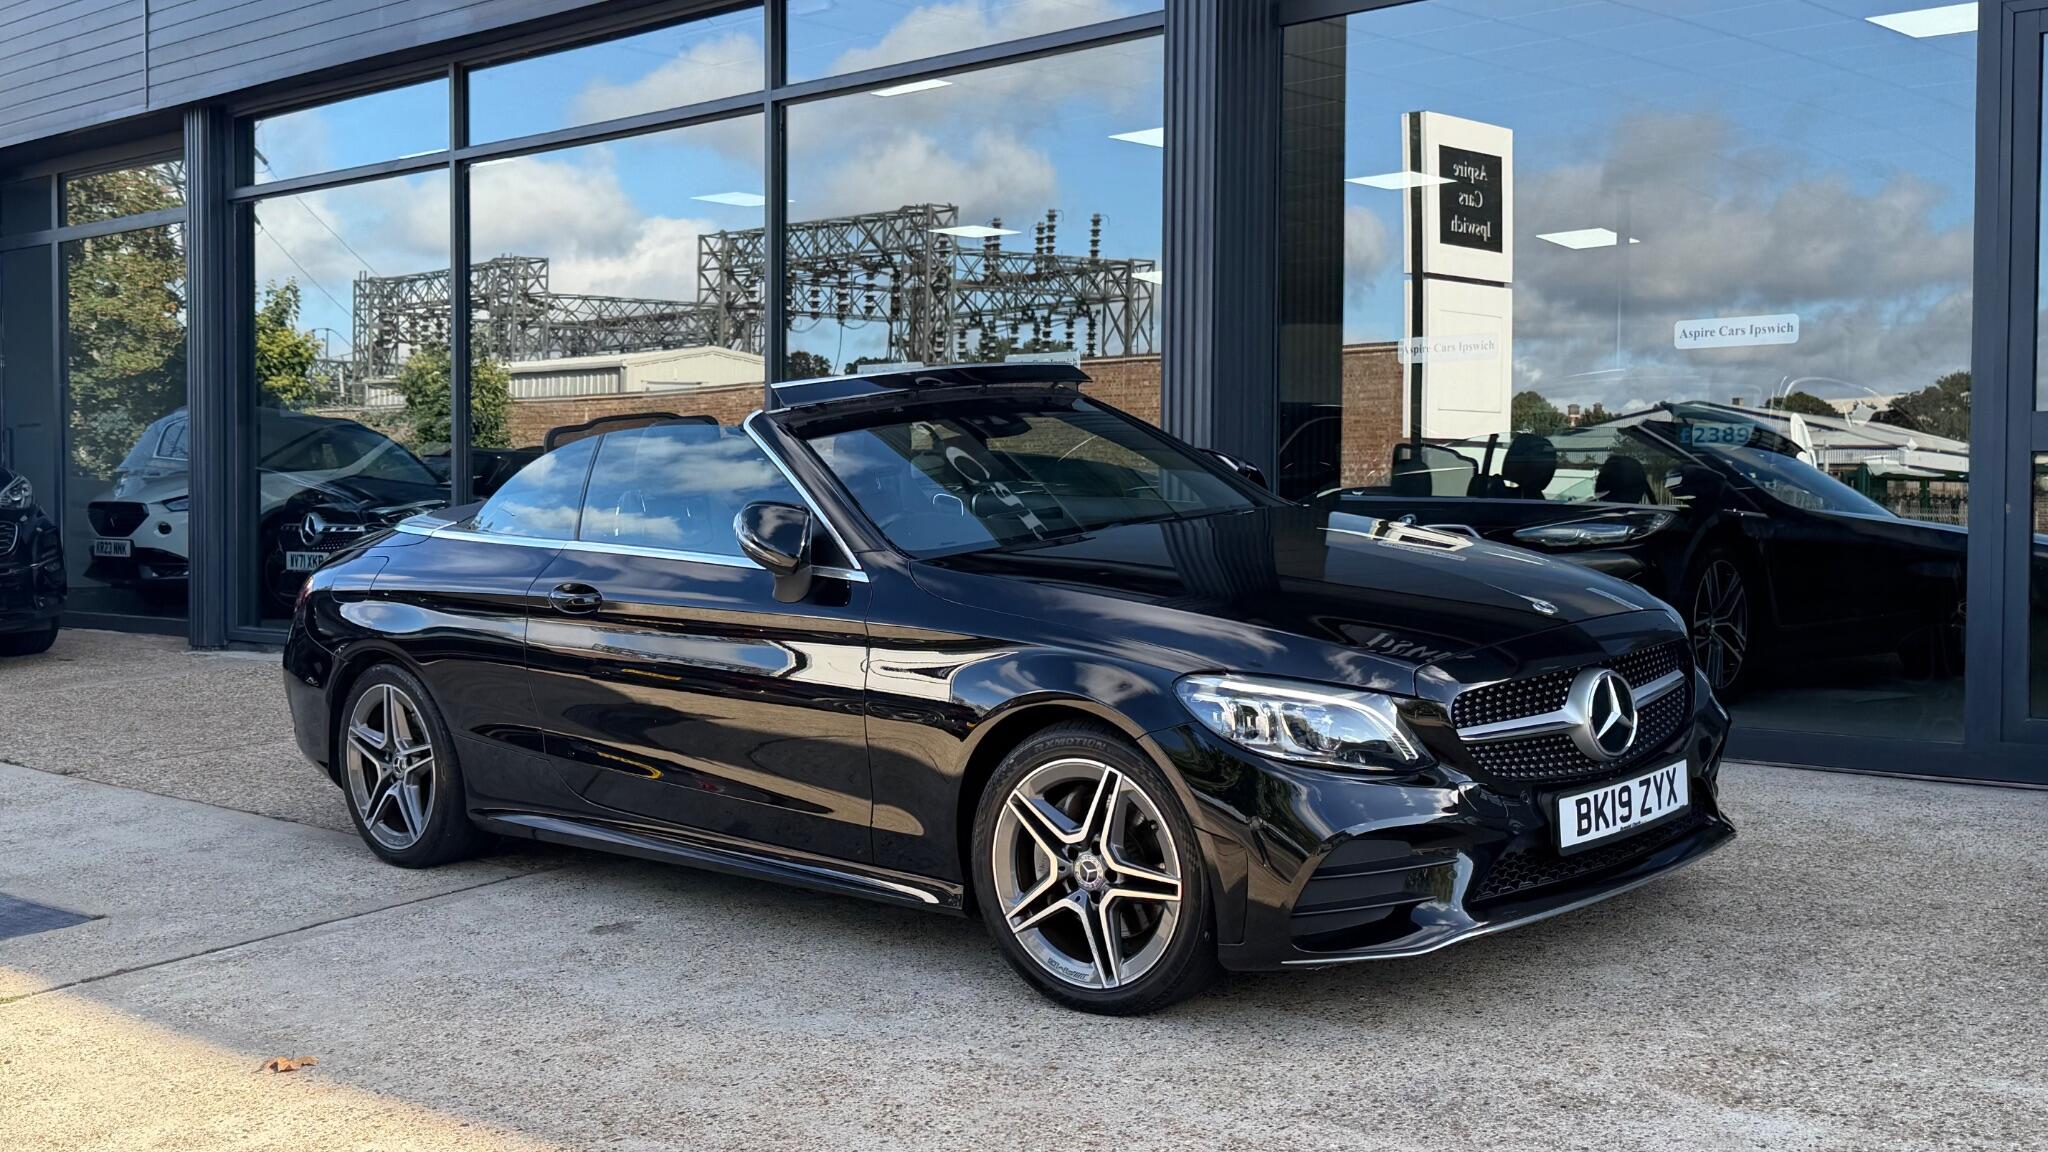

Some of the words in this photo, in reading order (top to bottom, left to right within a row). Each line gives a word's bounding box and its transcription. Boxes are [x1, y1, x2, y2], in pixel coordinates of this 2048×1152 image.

[1680, 327, 1716, 341] Aspire
[1719, 325, 1746, 337] Cars
[1750, 322, 1794, 338] Ipswich
[1458, 340, 1495, 355] Ipswich
[1575, 785, 1632, 837] BK19
[1639, 767, 1677, 817] ZYX
